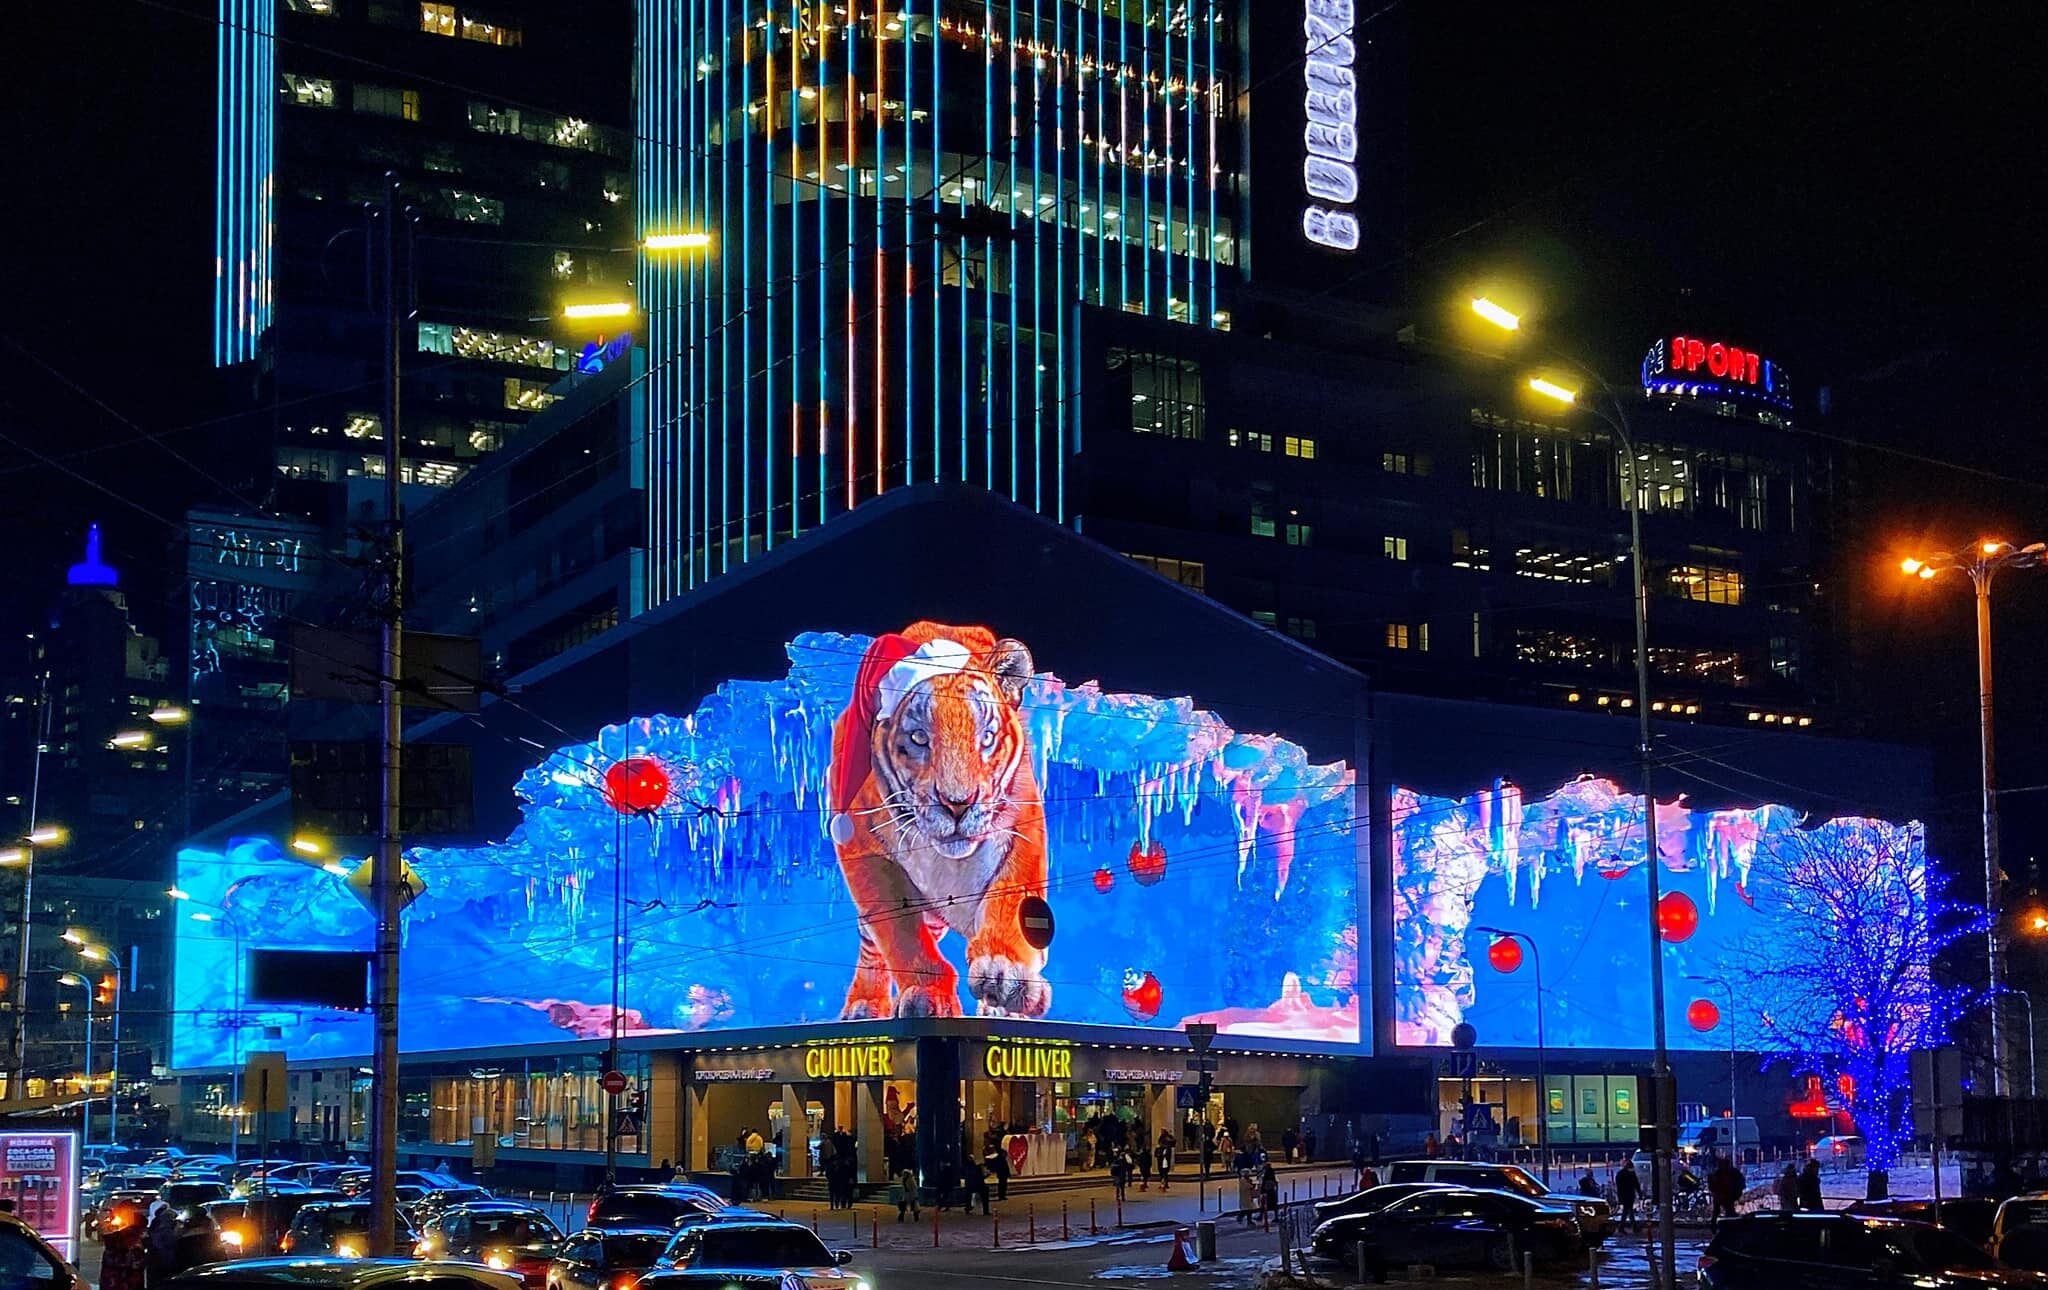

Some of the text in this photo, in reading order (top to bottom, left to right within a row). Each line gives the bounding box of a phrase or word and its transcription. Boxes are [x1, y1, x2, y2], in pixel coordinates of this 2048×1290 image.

[1671, 336, 1759, 384] SPORT
[805, 1045, 893, 1078] GULLIVER
[986, 1045, 1071, 1078] GULLIVER
